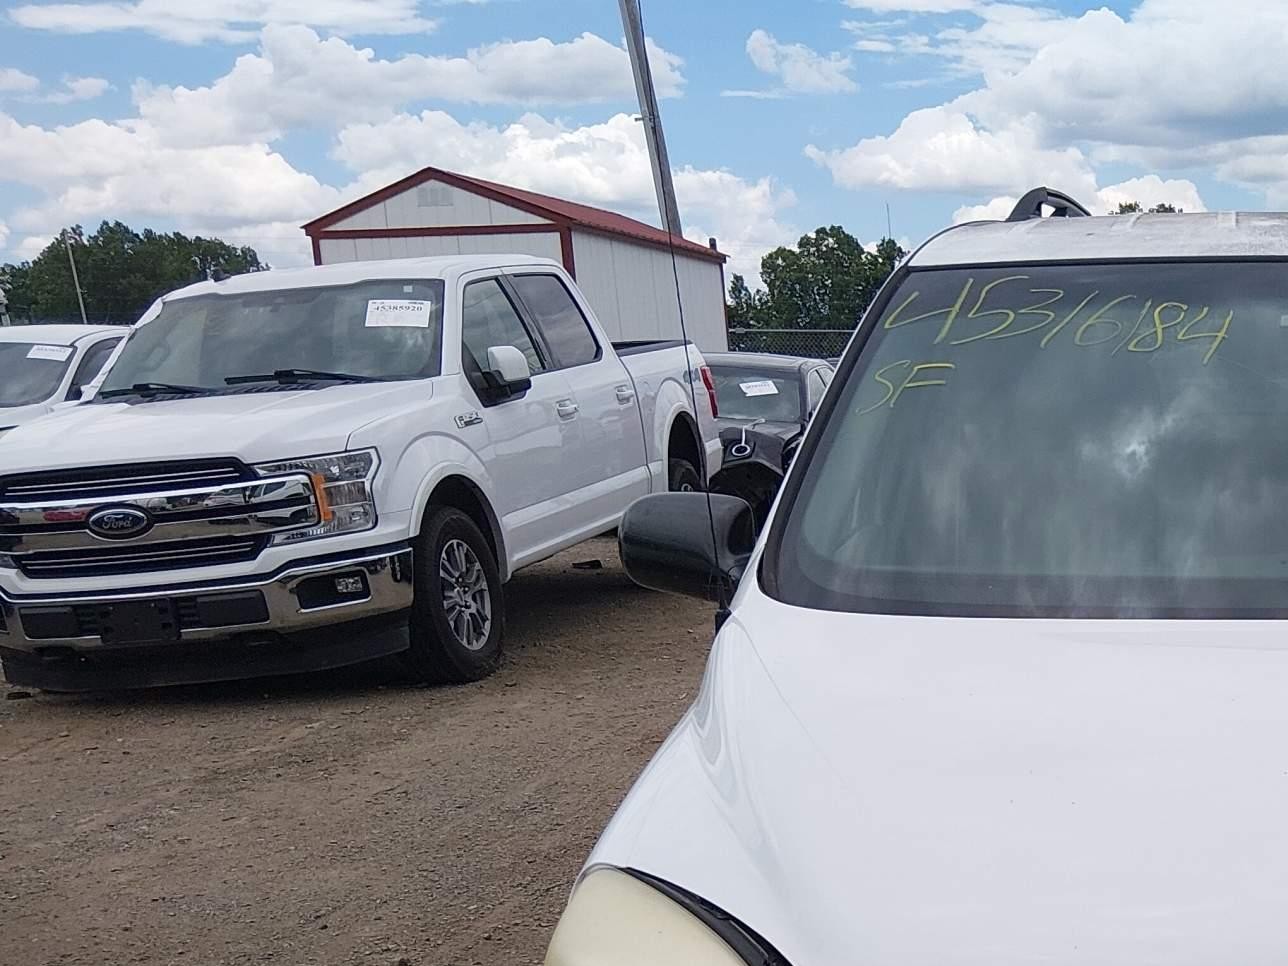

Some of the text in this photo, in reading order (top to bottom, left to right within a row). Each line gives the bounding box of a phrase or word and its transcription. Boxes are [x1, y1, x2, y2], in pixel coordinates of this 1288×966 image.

[885, 276, 1234, 365] 45316184
[856, 360, 955, 416] SF
[102, 514, 133, 529] Ford
